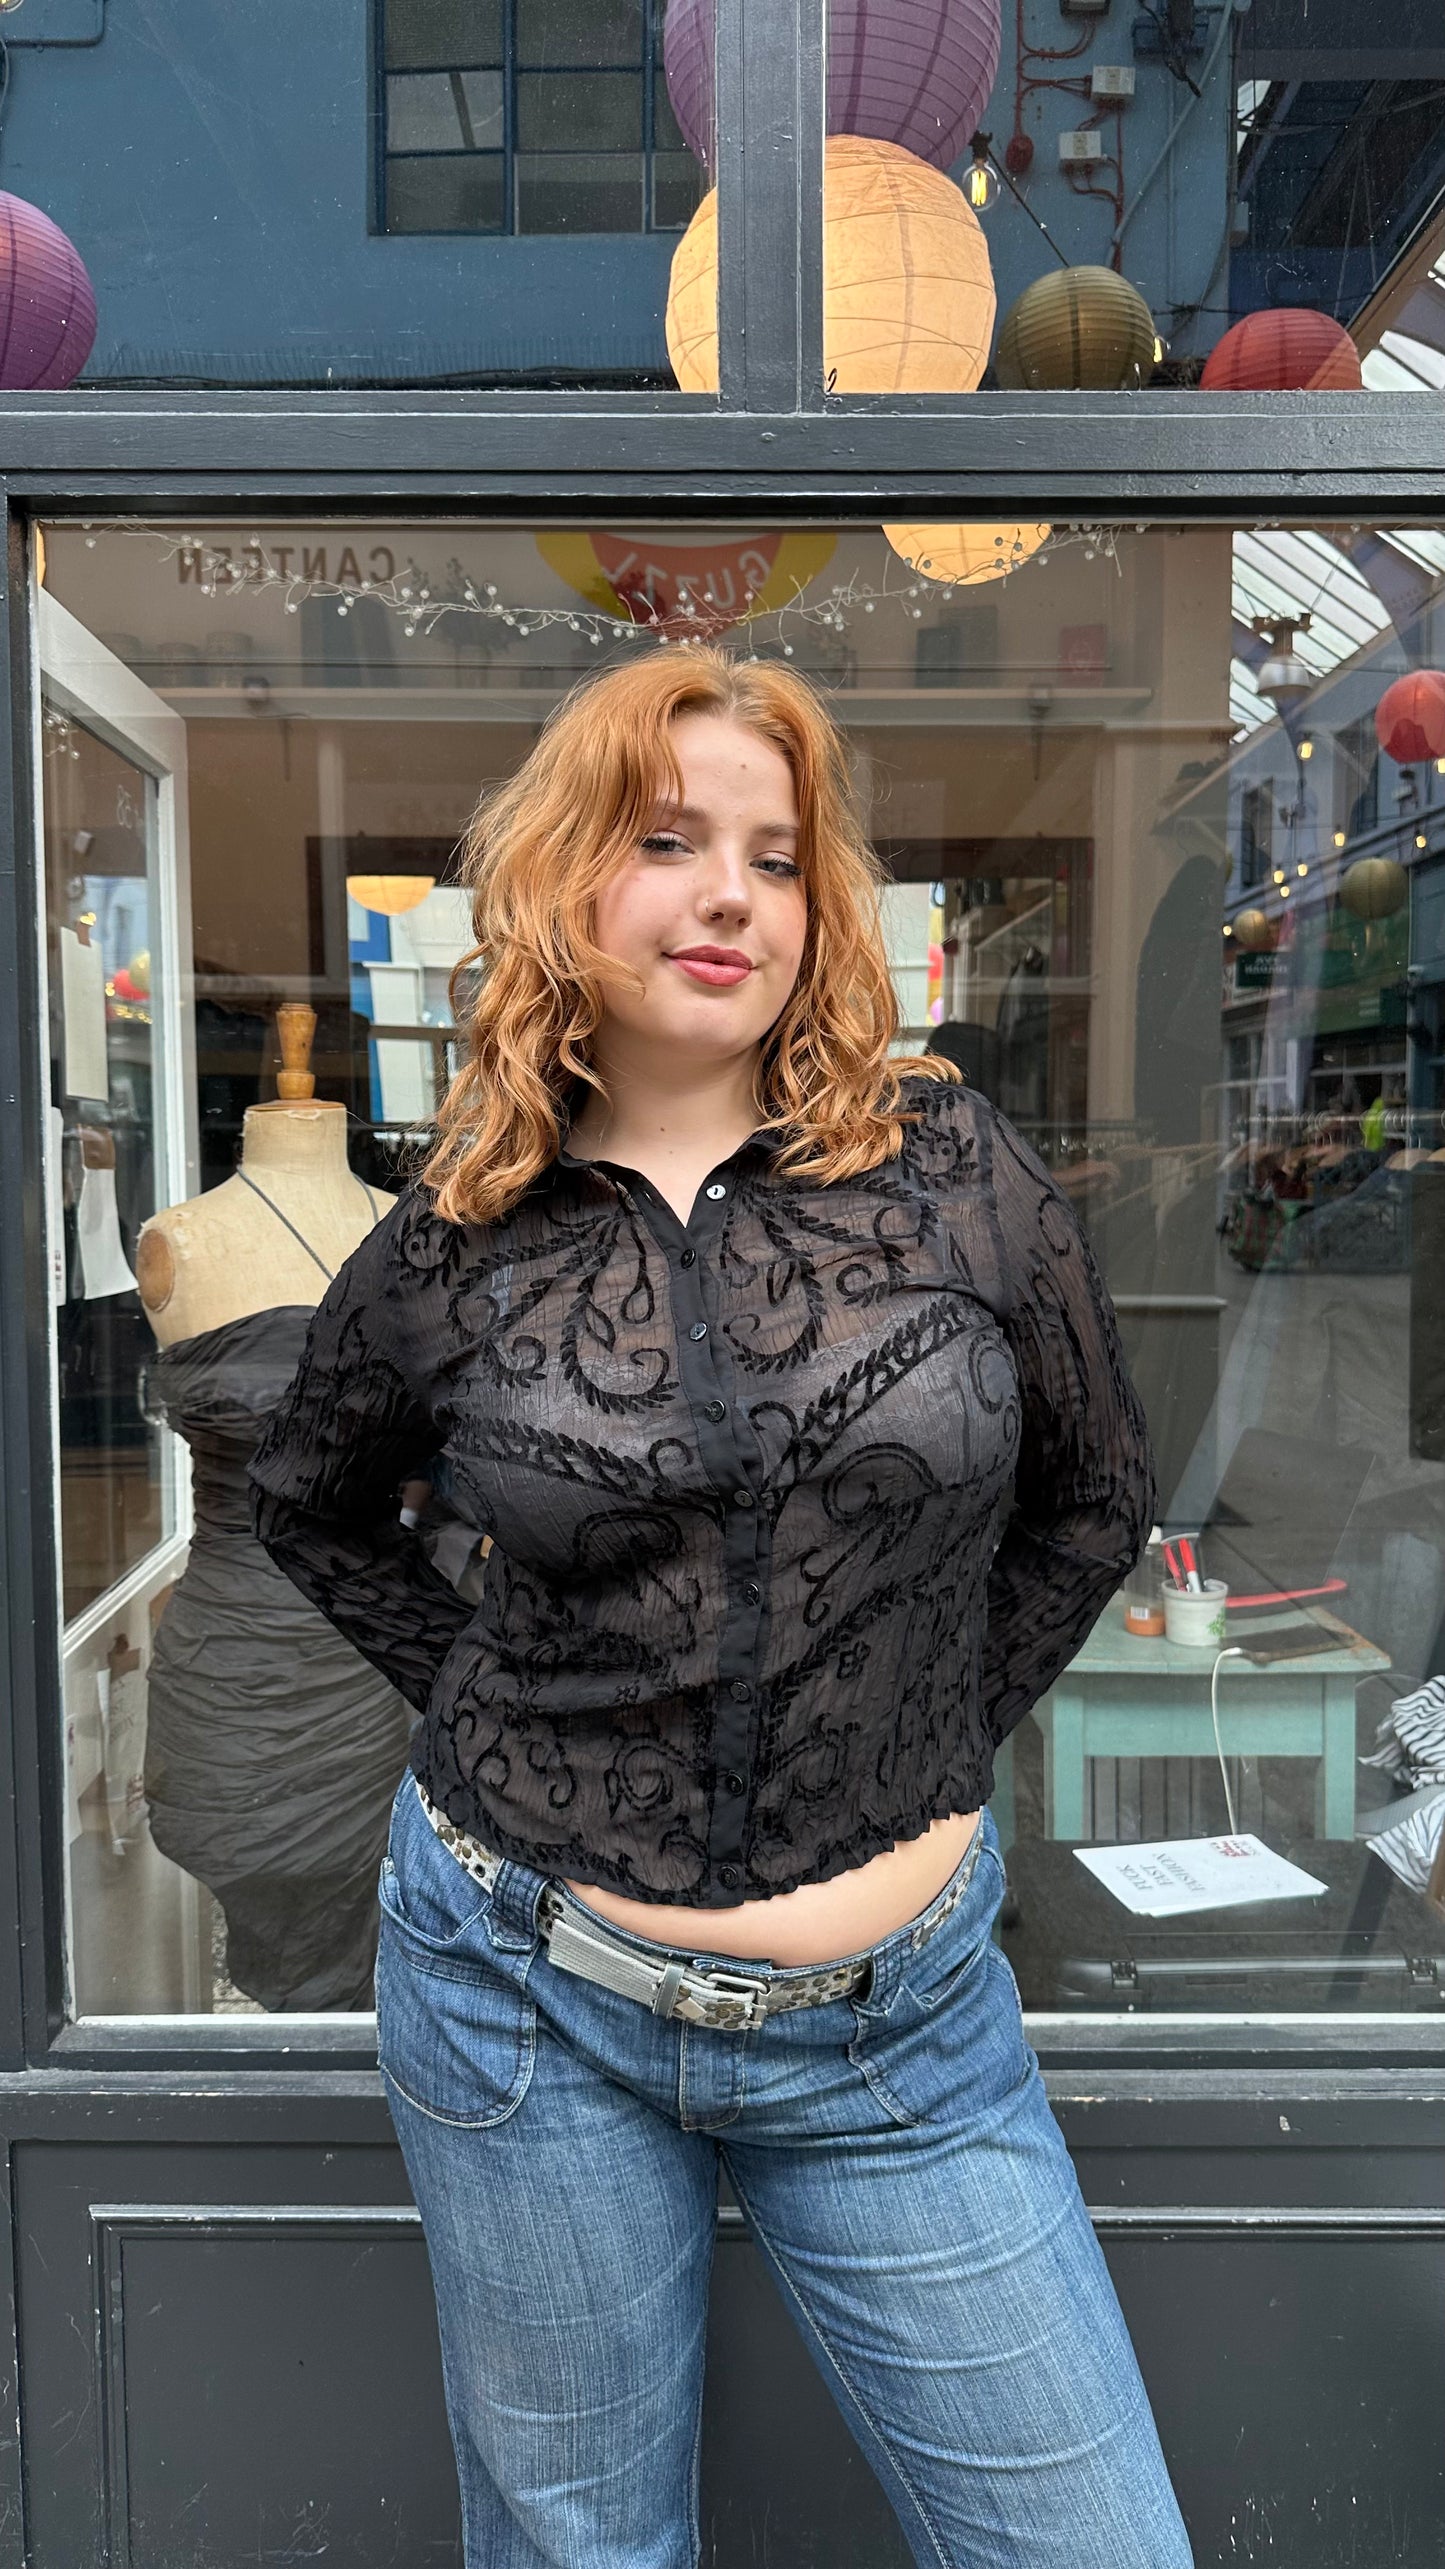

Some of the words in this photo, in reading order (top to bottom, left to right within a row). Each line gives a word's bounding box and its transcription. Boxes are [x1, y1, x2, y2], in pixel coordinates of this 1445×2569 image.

[1116, 1864, 1153, 1890] FUCK
[1139, 1864, 1174, 1886] FAST
[1152, 1853, 1206, 1891] FASHION
